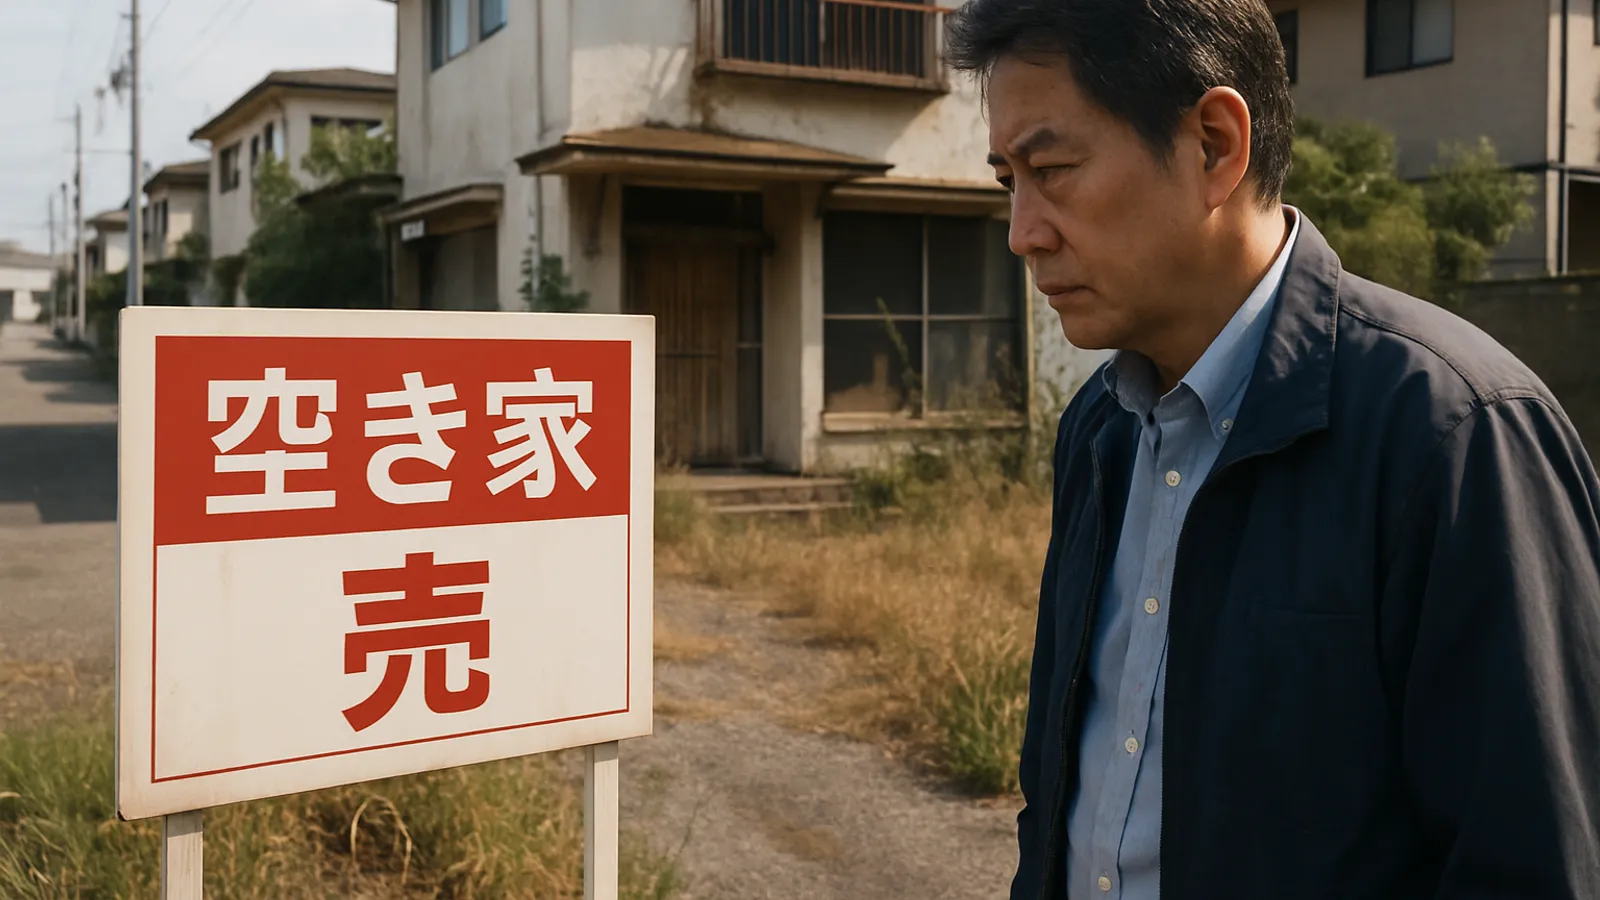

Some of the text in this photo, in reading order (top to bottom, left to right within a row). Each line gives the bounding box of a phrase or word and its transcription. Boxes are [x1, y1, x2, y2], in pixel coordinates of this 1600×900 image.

[206, 367, 597, 514] 空き家
[341, 551, 491, 733] 売
